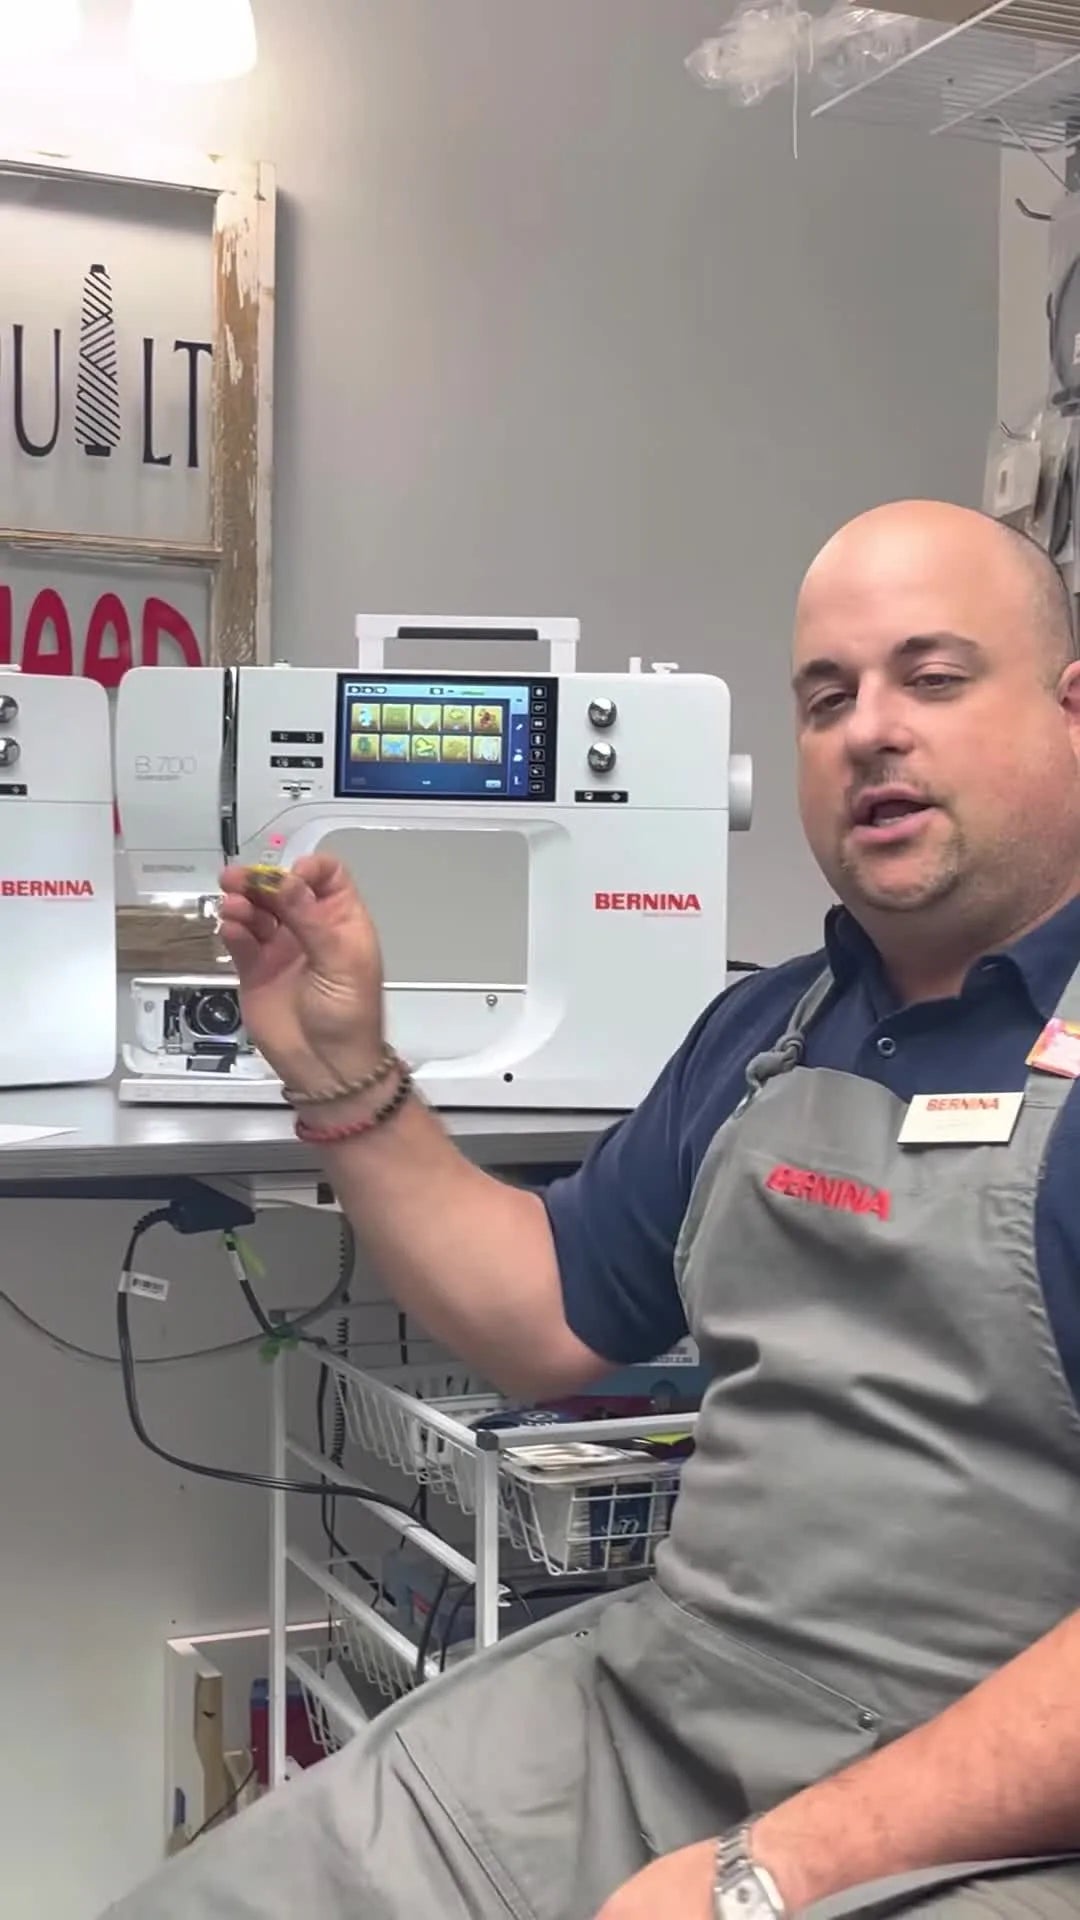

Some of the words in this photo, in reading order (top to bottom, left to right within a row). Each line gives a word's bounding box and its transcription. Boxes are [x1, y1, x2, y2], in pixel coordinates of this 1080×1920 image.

[134, 755, 151, 774] B
[156, 755, 197, 775] 700
[1, 880, 94, 897] BERNINA
[595, 892, 701, 911] BERNINA
[926, 1097, 1000, 1112] BERNINA
[766, 1164, 891, 1222] BERNINA
